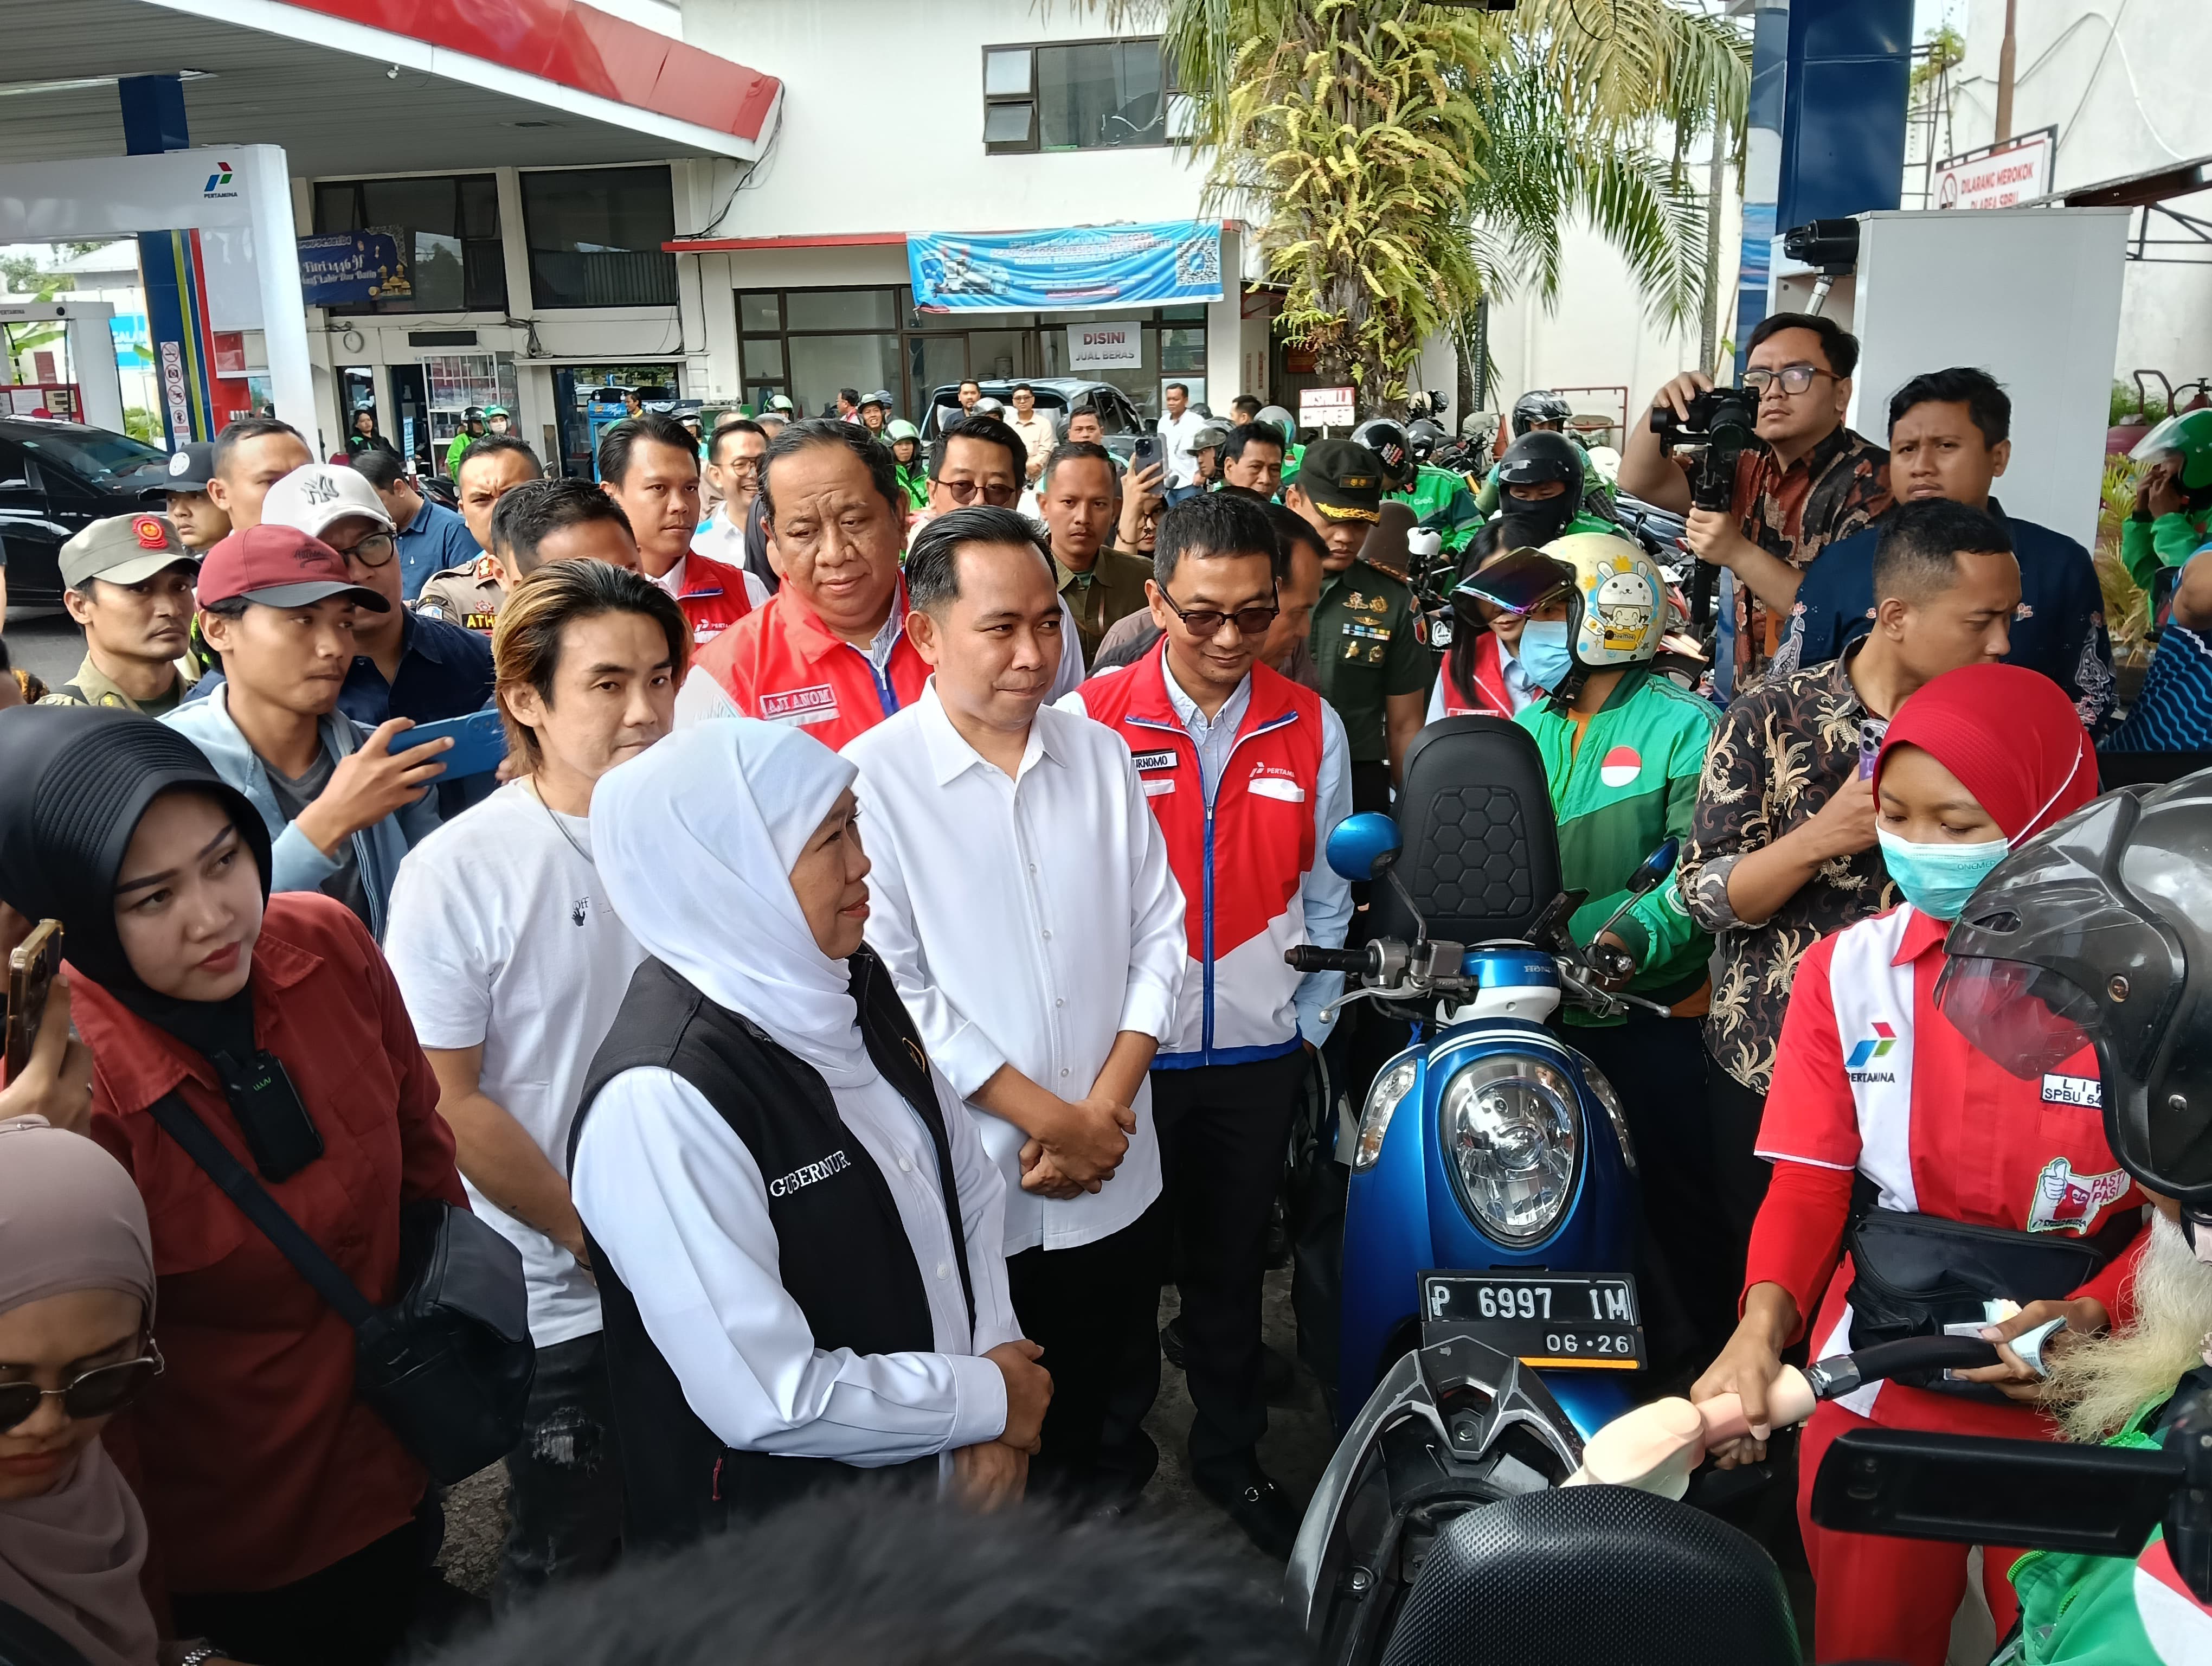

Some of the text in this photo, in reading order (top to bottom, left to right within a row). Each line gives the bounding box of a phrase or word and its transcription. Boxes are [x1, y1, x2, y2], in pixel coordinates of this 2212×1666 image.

[1960, 162, 2034, 195] DILARANG MEROKOK
[1083, 332, 1125, 345] DISINI
[1076, 350, 1134, 361] JUAL BERAS
[1413, 496, 1434, 505] Grab
[467, 614, 497, 628] ATH
[768, 689, 832, 713] AJI ANOM
[1958, 860, 1996, 870] ONEMED
[572, 896, 589, 911] Off
[2044, 1088, 2081, 1103] SPBU
[770, 1150, 851, 1197] GUBERNUR
[1431, 1286, 1629, 1321] P 6997 IM
